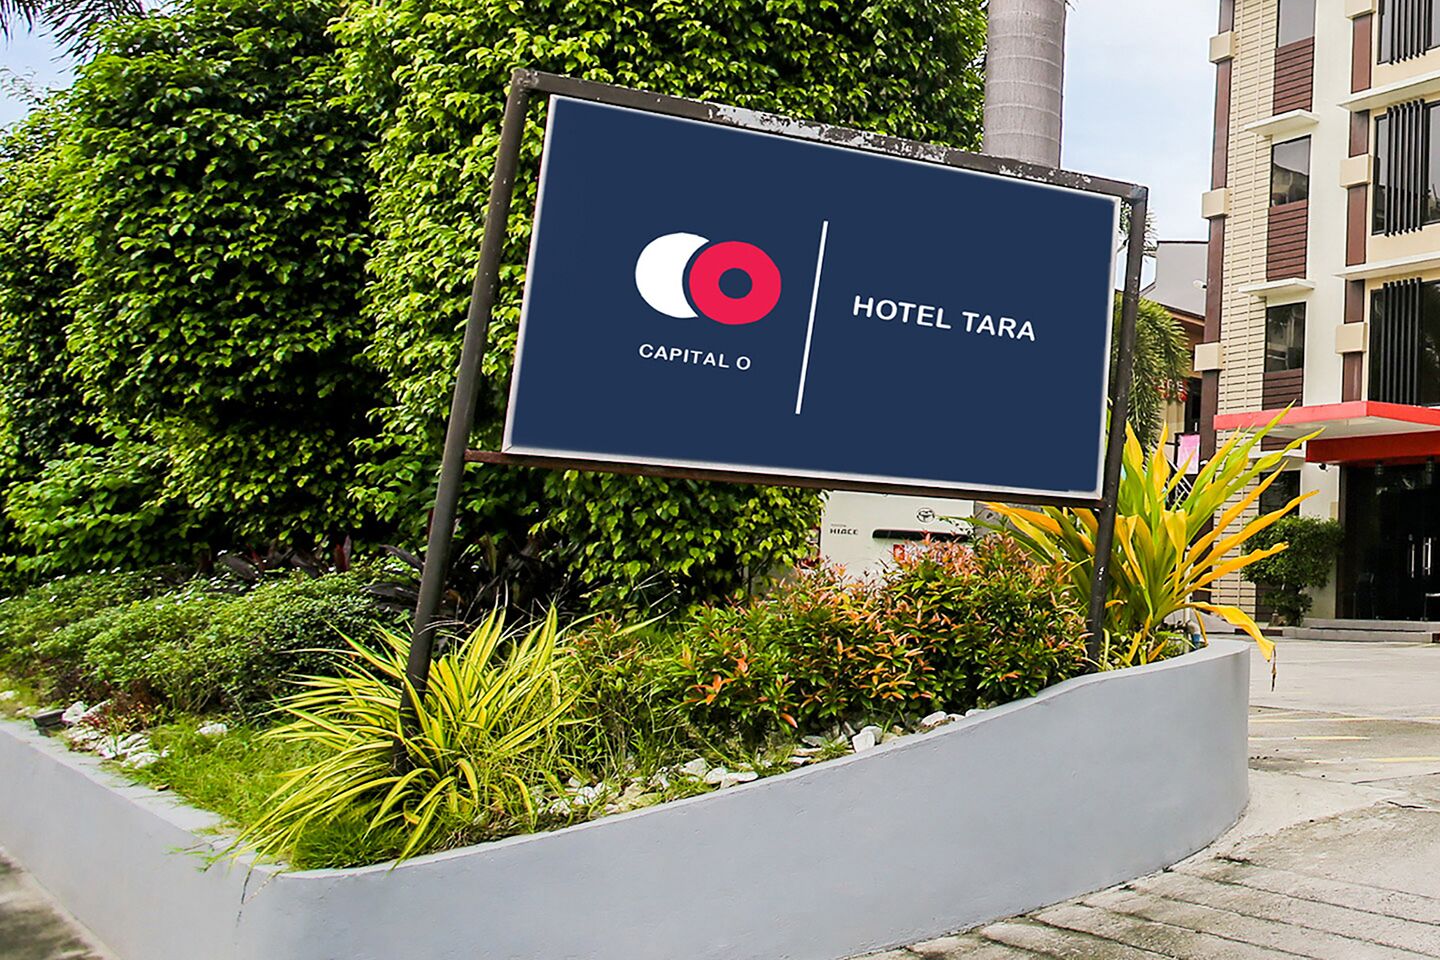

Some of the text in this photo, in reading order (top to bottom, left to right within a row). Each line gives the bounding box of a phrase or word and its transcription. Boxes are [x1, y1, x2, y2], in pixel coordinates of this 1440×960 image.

[852, 295, 1036, 342] HOTEL TARA
[638, 343, 751, 371] CAPITAL O
